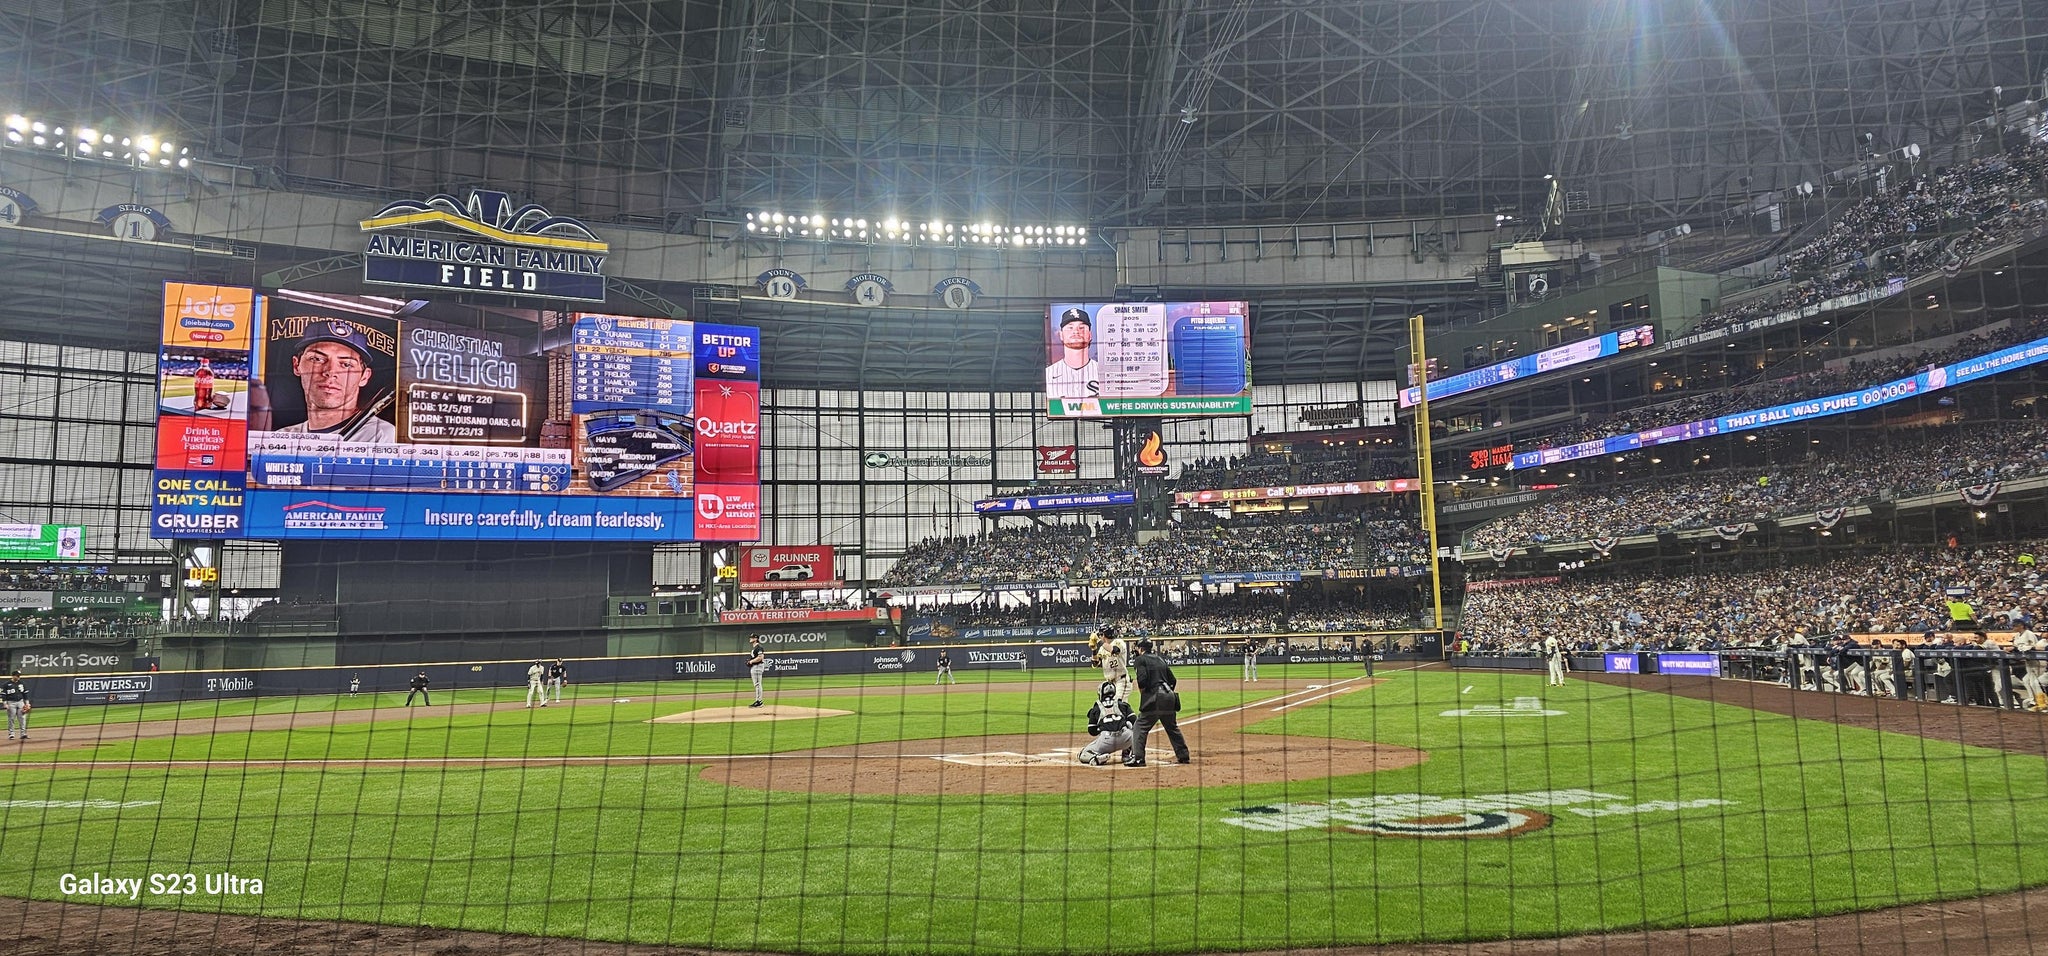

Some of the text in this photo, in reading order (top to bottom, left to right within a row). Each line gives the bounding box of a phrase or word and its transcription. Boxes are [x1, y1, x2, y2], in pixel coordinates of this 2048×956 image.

[118, 204, 152, 215] SELIG
[129, 220, 142, 240] 1
[366, 234, 606, 274] AMERICAN FAMILY
[441, 264, 537, 291] FIELD
[768, 270, 795, 279] YOUNT
[852, 274, 887, 285] MOLITOR
[943, 278, 971, 287] UECKER
[771, 281, 792, 297] 19
[863, 286, 875, 302] 4
[181, 295, 236, 317] Joie
[1132, 306, 1148, 314] SMITH
[411, 328, 502, 358] CHRISTIAN
[702, 333, 751, 347] BETTOR
[1664, 324, 1744, 350] TO REPORT FAN TEXT
[718, 346, 736, 358] UP
[410, 348, 517, 389] YELICH
[1956, 368, 1970, 378] SEE
[1970, 364, 1984, 374] ALL
[1985, 358, 2000, 368] THE
[2001, 352, 2025, 366] HOME
[412, 390, 493, 404] HT: WT: 220
[412, 402, 472, 414] DOB: 12/5/91
[1106, 402, 1133, 410] WE'RE
[1134, 402, 1168, 410] DRIVING
[1726, 384, 1906, 428] THAT BALL WAS PURE POWER
[1298, 403, 1364, 422] Johnsonville
[412, 414, 521, 427] BORN: THOUSAND OAKS, CA
[186, 427, 210, 435] Drink
[412, 426, 484, 436] DEBUT: 7/23/13
[696, 416, 757, 438] Quartz
[181, 435, 224, 444] America's
[420, 448, 438, 456] .343
[1492, 444, 1514, 454] MARKET
[894, 456, 991, 466] Aurora Health Care
[1522, 454, 1538, 464] 1:27
[265, 462, 288, 472] WHITE
[494, 470, 499, 478] 4
[506, 470, 512, 478] 2
[158, 479, 242, 492] ONE CALL...
[267, 475, 302, 485] BREWERS
[506, 481, 512, 489] 2
[1222, 491, 1234, 499] Be
[1236, 490, 1257, 498] safe.
[1266, 488, 1284, 497] Call
[1296, 486, 1326, 496] before
[1326, 486, 1343, 496] you
[1344, 484, 1361, 494] dig.
[157, 494, 243, 506] THAT'S ALL!
[726, 502, 755, 510] credit
[1458, 502, 1472, 511] FROZEN
[1472, 501, 1484, 510] PIZZA
[1496, 496, 1518, 506] MILWAUKEE
[1519, 494, 1538, 503] BREWERS
[285, 512, 384, 521] AMERICAN FAMILY
[424, 508, 665, 531] Insure carefully, dream fearlessly.
[726, 510, 756, 518] union
[158, 514, 239, 528] GRUBER
[773, 554, 820, 562] 4RUNNER
[190, 568, 217, 581] 0:05
[718, 566, 738, 578] 0:05
[1338, 568, 1386, 578] NICOLET LAW
[1091, 578, 1144, 588] 620 WTMJ
[60, 596, 126, 604] POWER ALLEY
[722, 610, 811, 621] TOYOTA TERRITORY
[76, 654, 120, 666] Save
[968, 652, 1020, 662] WINTRUST
[1056, 656, 1079, 664] Health
[686, 662, 716, 672] Mobile
[1110, 660, 1118, 668] 22
[1614, 657, 1632, 670] SKYY
[78, 680, 147, 691] BREWERS.TV
[219, 678, 254, 691] Mobile
